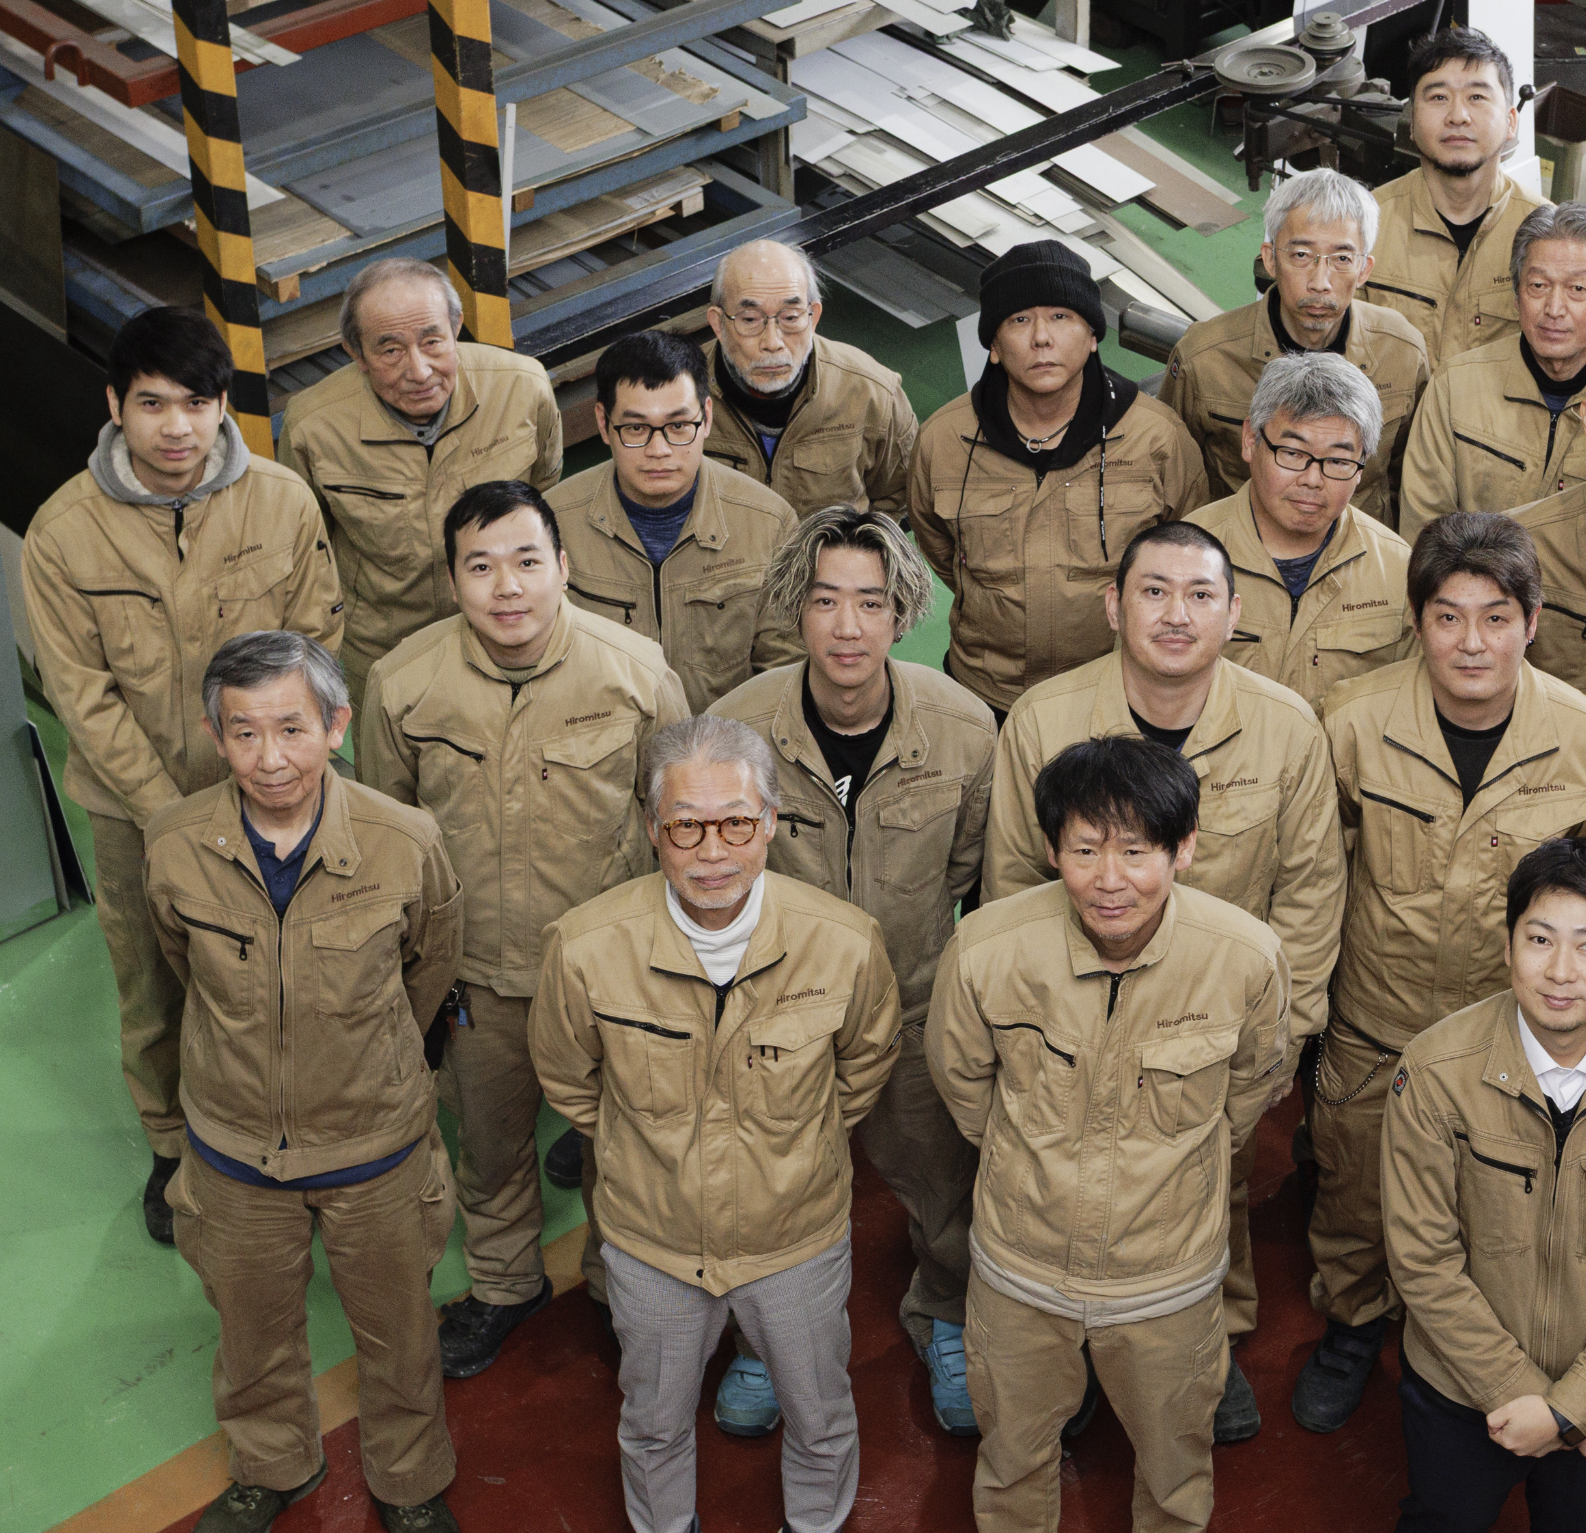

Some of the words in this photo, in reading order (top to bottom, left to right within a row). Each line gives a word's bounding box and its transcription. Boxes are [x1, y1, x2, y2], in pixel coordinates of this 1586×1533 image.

[702, 557, 745, 573] Hiromitsu
[1342, 599, 1388, 612] Hiromitsu
[565, 710, 612, 727] Hiromitsu
[898, 769, 943, 788] Hiromitsu
[1211, 777, 1258, 791] Hiromitsu
[1518, 783, 1566, 796] Hiromitsu
[332, 883, 381, 903] Hiromitsu
[776, 988, 826, 1005] Hiromitsu
[1156, 1012, 1209, 1029] Hiromitsu
